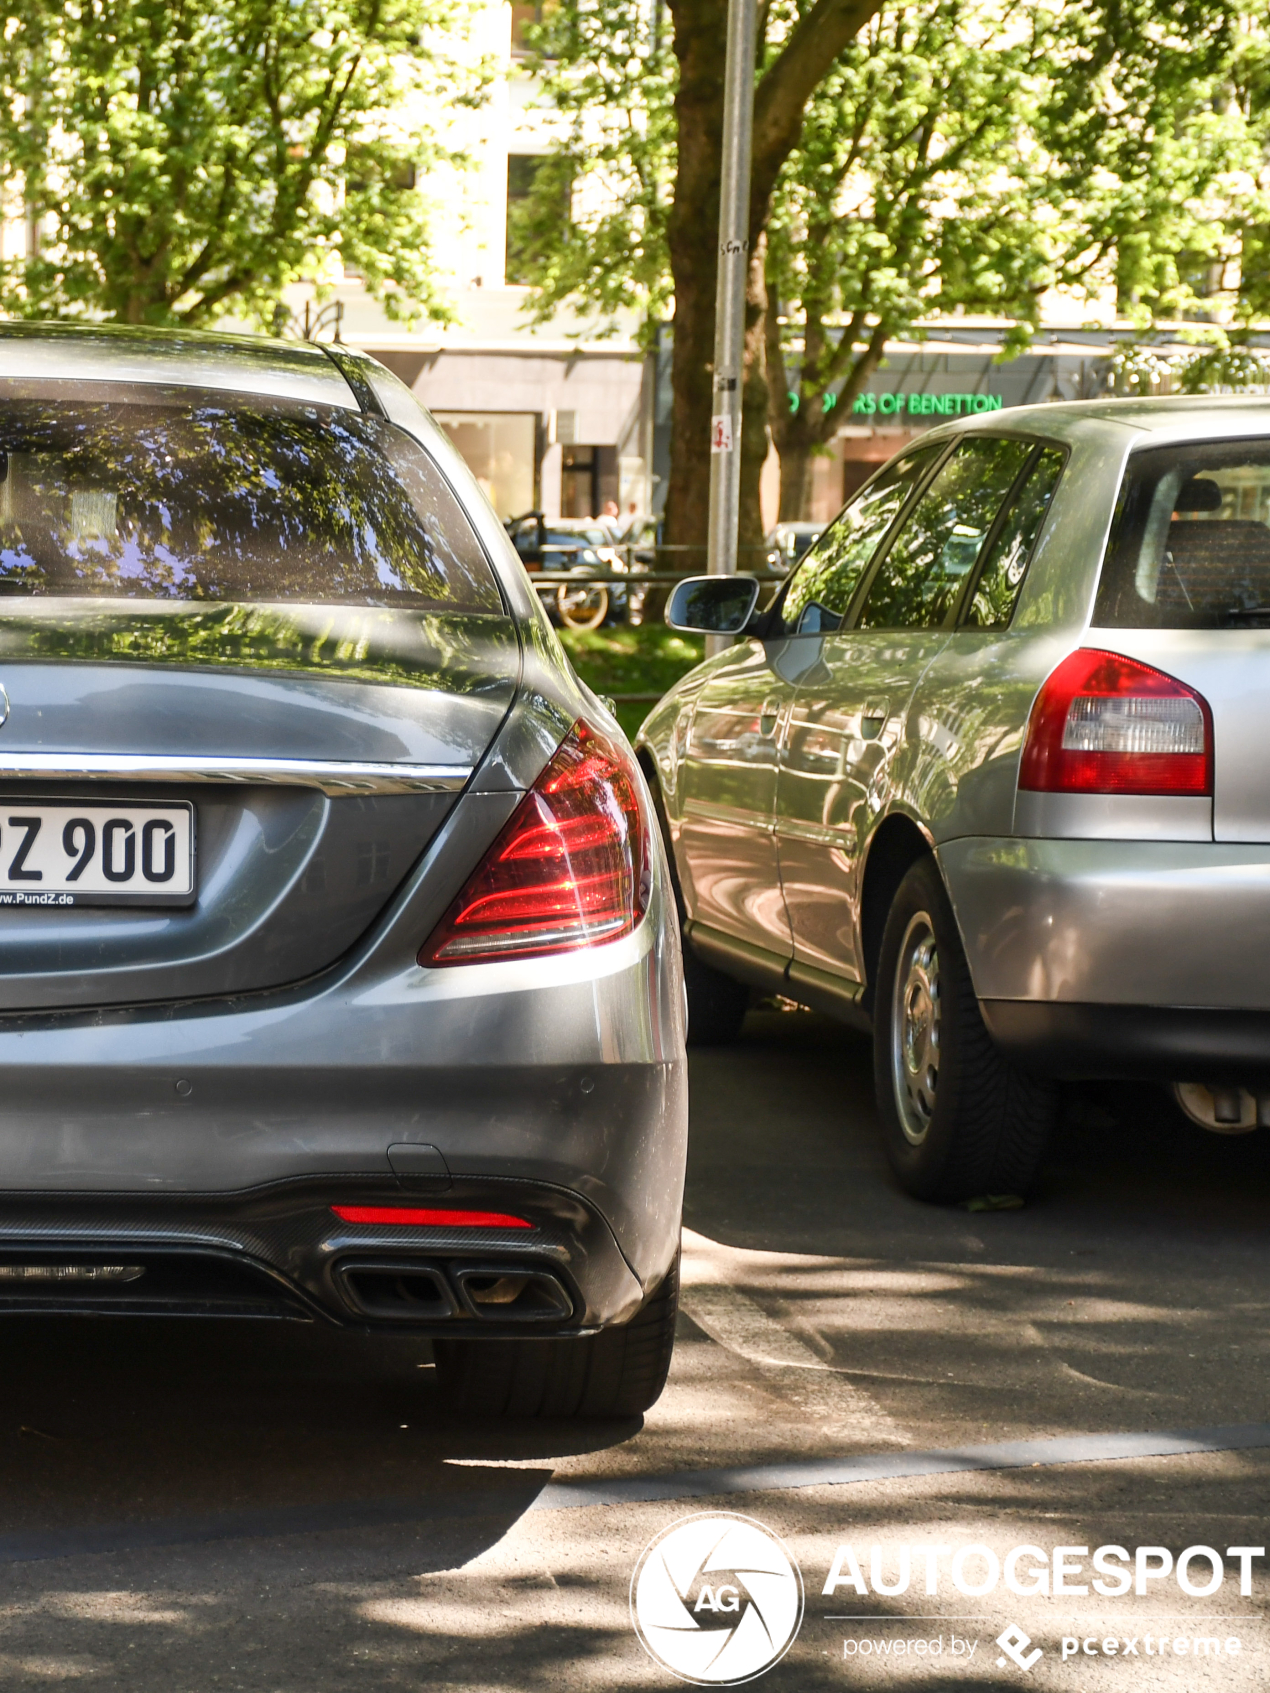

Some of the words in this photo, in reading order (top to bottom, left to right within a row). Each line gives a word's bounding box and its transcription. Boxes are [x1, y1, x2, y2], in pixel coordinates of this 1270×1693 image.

[879, 393, 906, 414] OF
[908, 394, 1003, 415] BENETTON
[62, 818, 175, 882] 900
